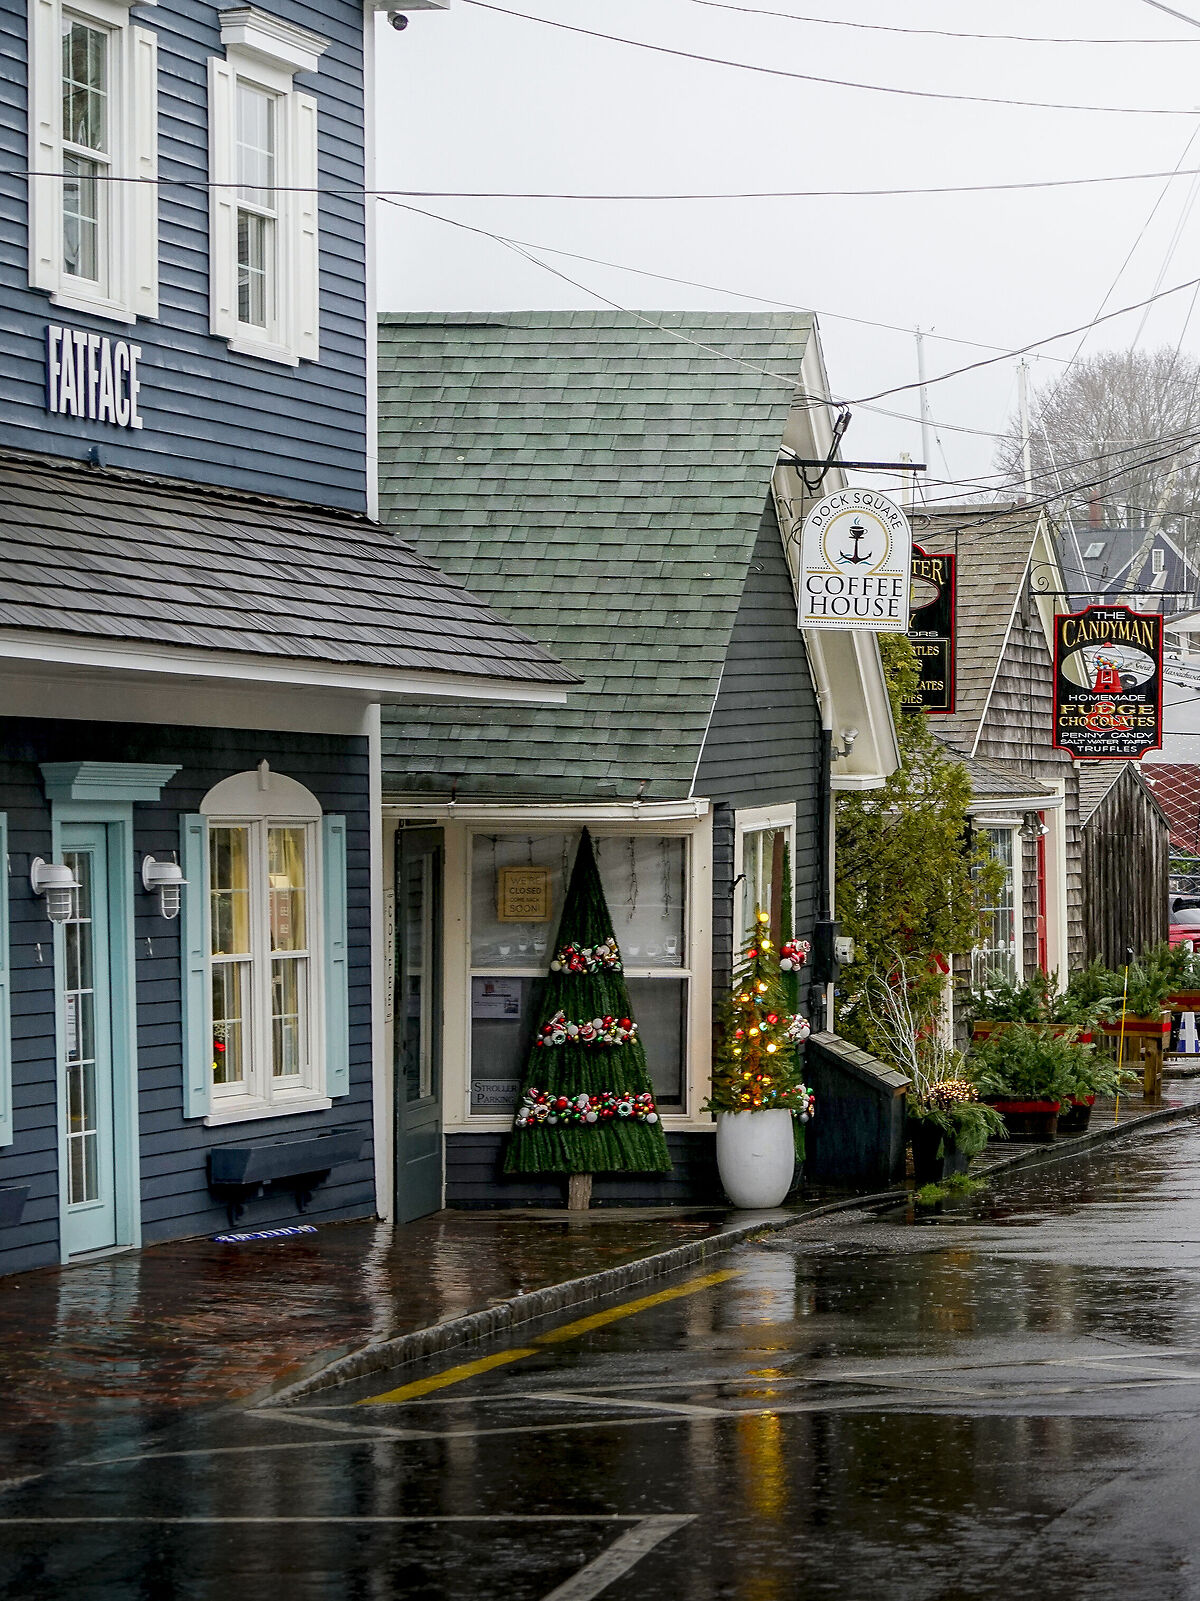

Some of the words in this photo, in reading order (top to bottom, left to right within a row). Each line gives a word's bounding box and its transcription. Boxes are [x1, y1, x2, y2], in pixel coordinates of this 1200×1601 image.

[47, 324, 143, 430] FATFACE
[811, 494, 849, 527] DOCK
[853, 492, 903, 530] SQUARE
[911, 559, 945, 585] TER
[806, 575, 903, 597] COFFEE
[809, 595, 899, 617] HOUSE
[1093, 611, 1126, 620] THE
[1062, 619, 1155, 650] CANDYMAN
[1068, 694, 1147, 702] HOMEMADE
[1060, 704, 1155, 715] FUDGE
[1059, 716, 1156, 727] CHOCOLATES
[1076, 745, 1138, 753] TRUFFLES
[509, 887, 541, 895] CLOSED
